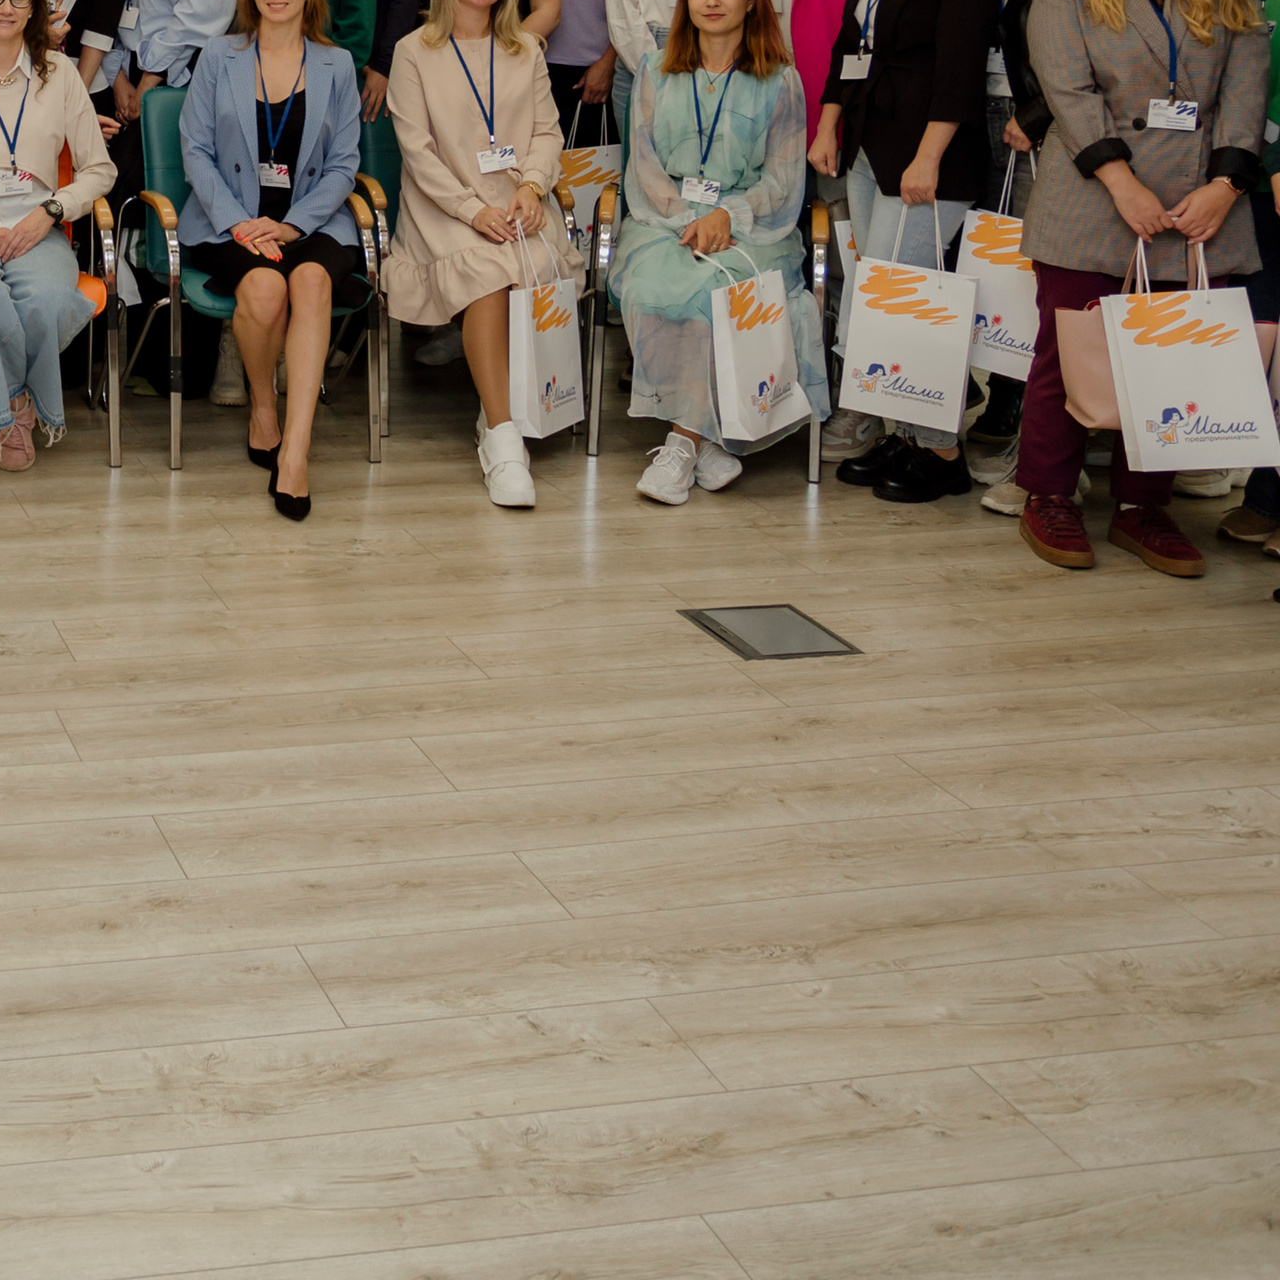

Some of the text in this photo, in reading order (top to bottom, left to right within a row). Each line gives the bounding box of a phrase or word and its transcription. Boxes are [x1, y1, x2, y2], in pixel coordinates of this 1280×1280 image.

[882, 376, 945, 401] Мама
[1184, 415, 1258, 436] Мама
[1185, 435, 1260, 443] предприниматель
